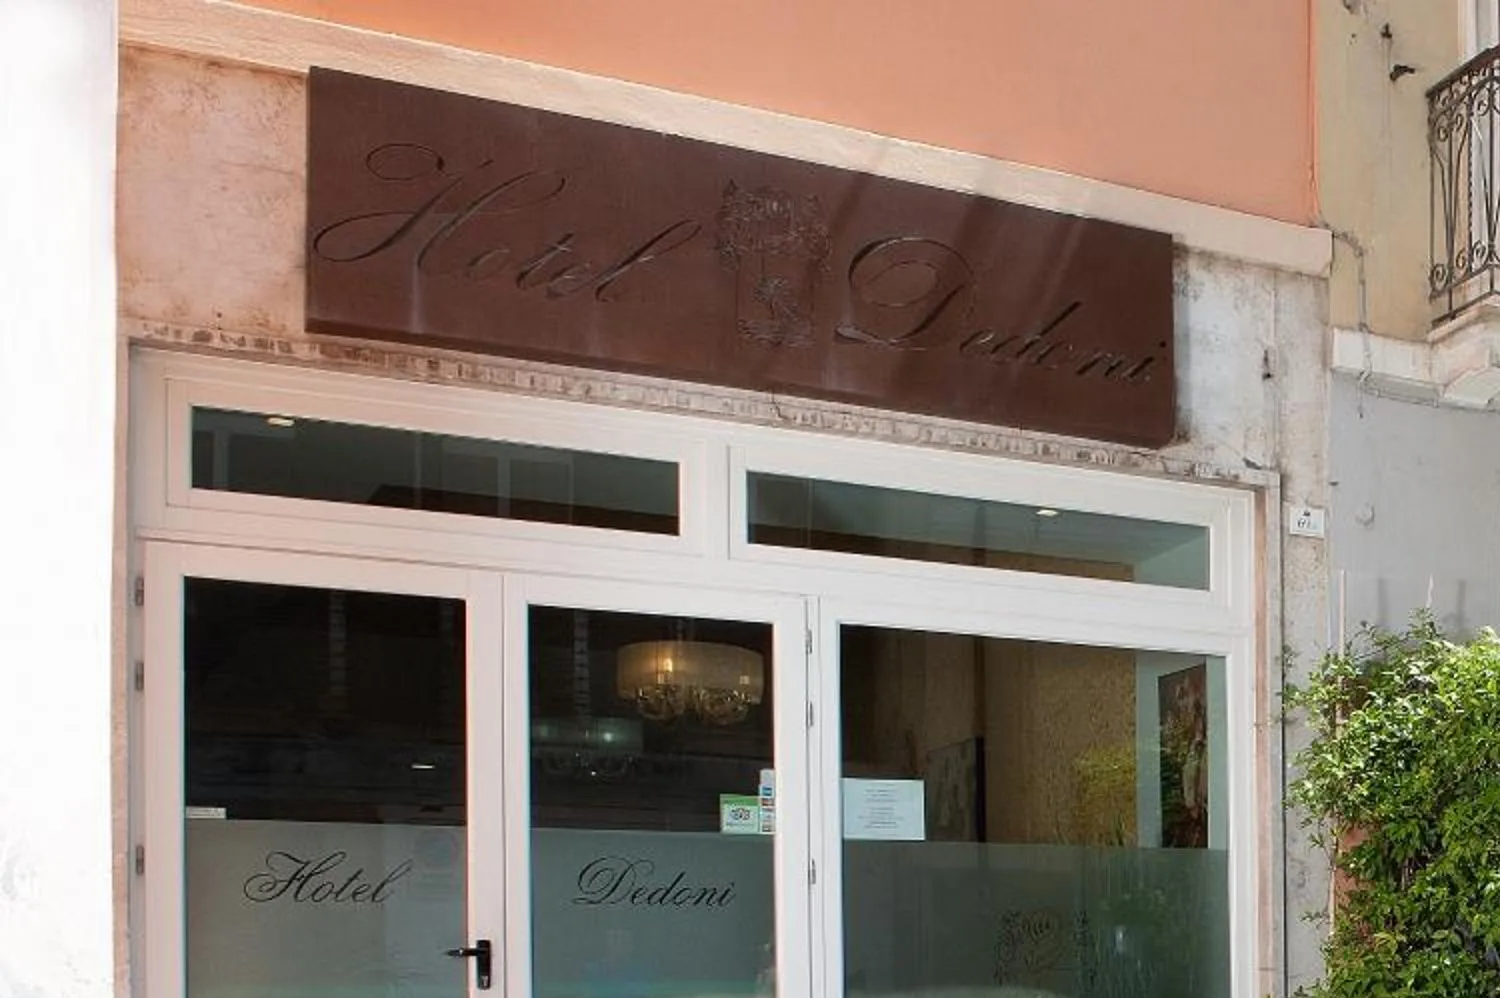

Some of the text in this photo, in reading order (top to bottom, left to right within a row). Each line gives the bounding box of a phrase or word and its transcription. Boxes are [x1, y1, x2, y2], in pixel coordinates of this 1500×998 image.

[313, 142, 703, 302] Hotel
[243, 851, 738, 907] Hotel Dedoni
